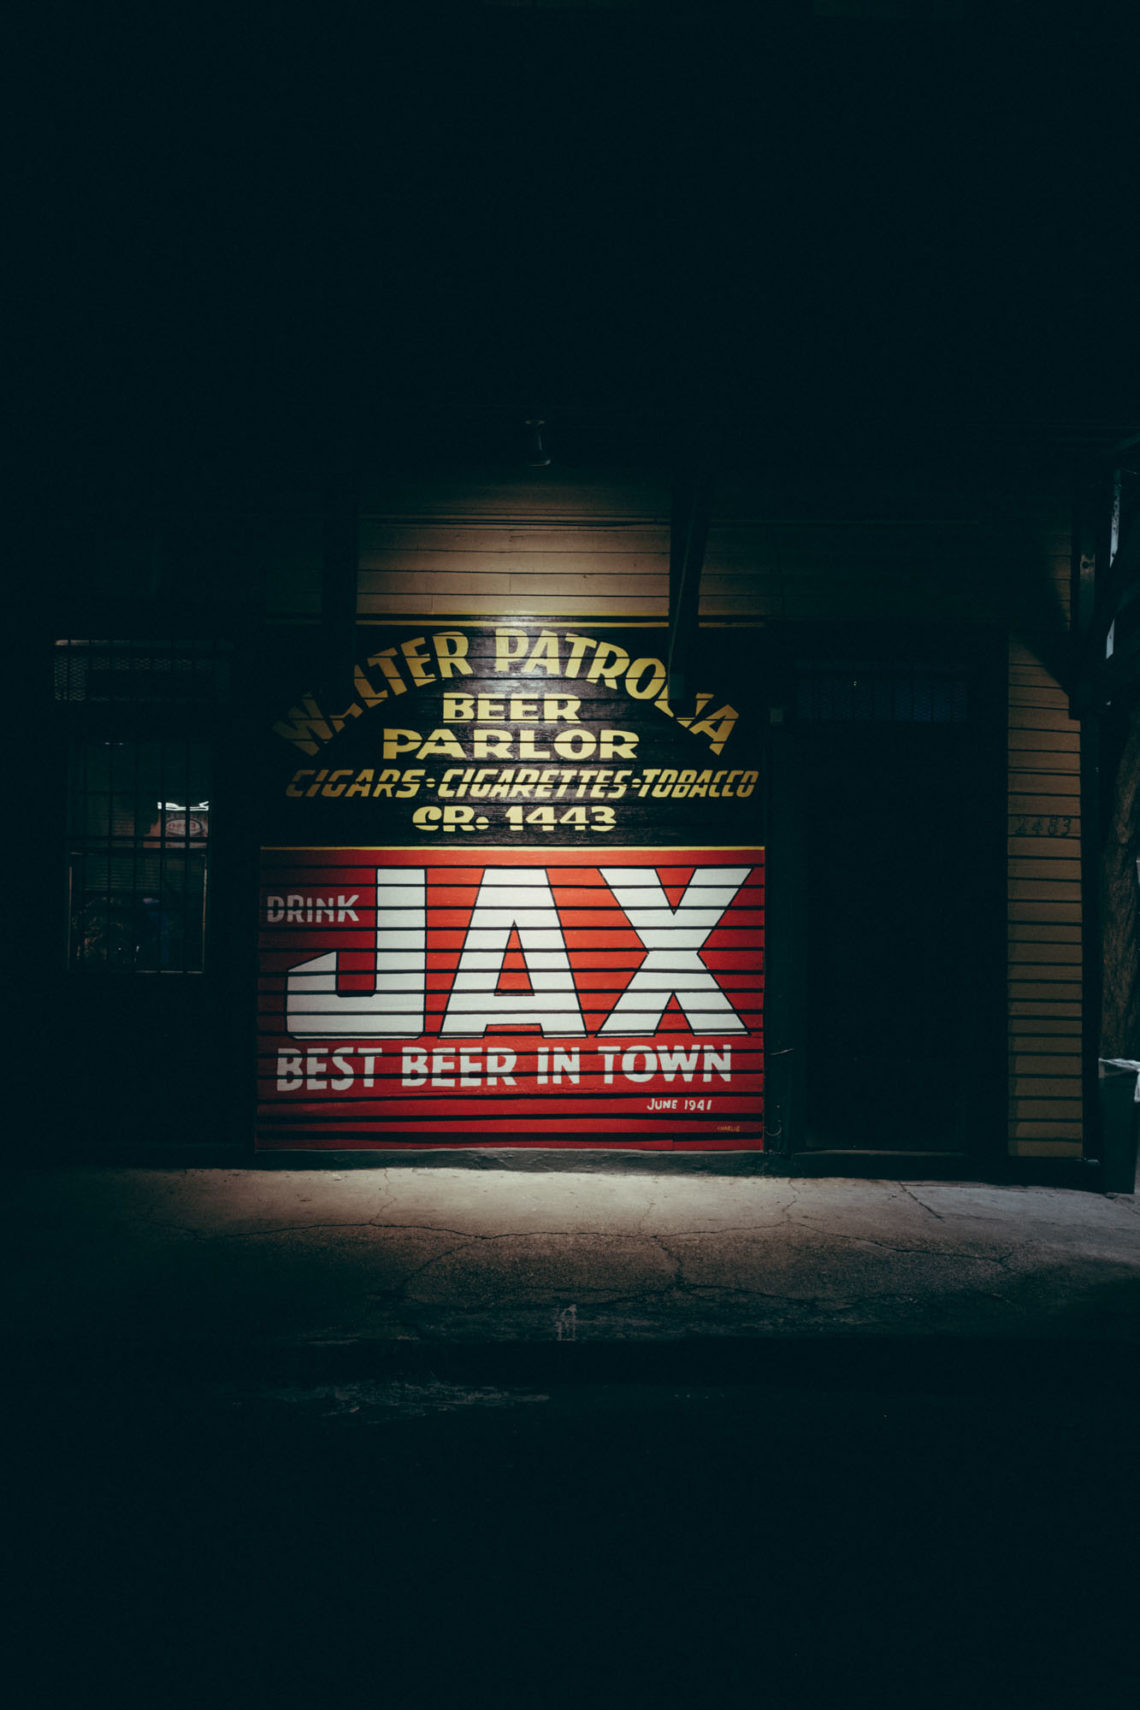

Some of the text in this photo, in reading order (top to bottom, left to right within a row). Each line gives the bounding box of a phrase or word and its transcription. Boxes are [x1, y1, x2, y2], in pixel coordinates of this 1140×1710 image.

[442, 692, 582, 723] BEER
[382, 728, 640, 760] PARLOR
[285, 768, 759, 799] CIGARS CIGARETTES TOBACCO
[412, 805, 617, 832] CR. 1443
[266, 894, 360, 923] DRINK
[285, 867, 753, 1040] JAX
[276, 1044, 732, 1092] BEST BEER IN TOWN
[646, 1097, 712, 1111] JUNE 1941
